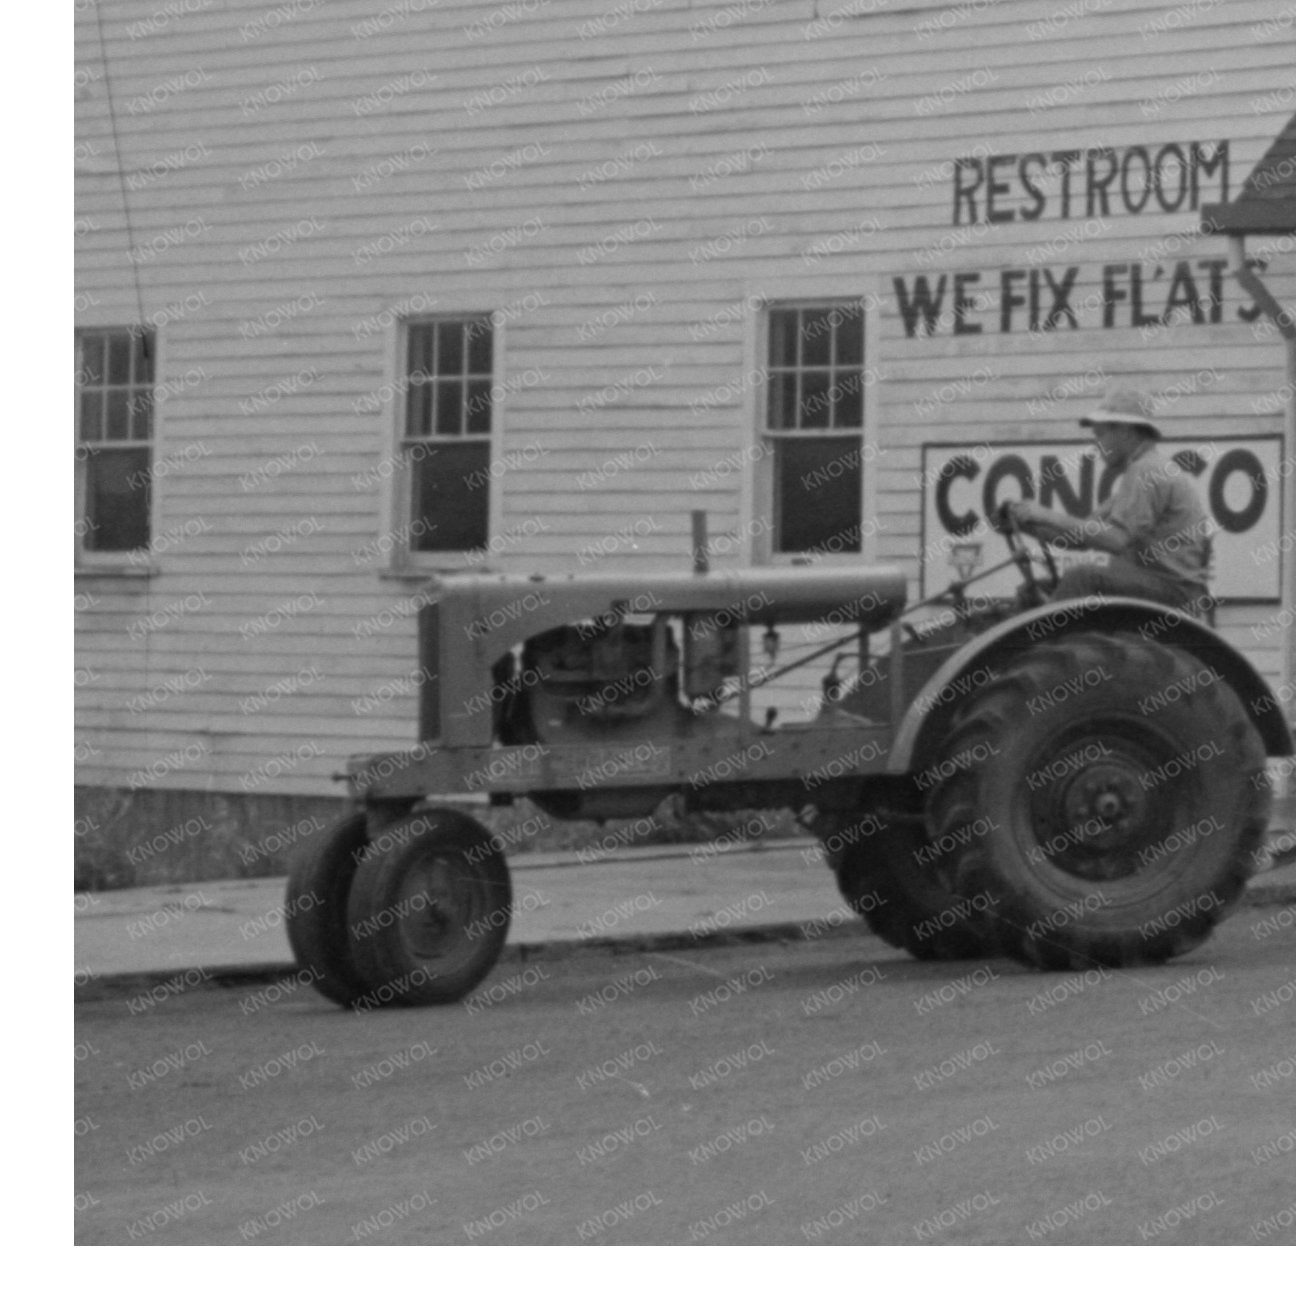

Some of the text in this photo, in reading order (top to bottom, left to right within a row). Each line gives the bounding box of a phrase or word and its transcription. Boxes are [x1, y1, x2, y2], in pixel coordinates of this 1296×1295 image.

[953, 139, 1231, 226] RESTROOM
[893, 272, 983, 338] WE
[1001, 266, 1080, 333] FIX
[936, 448, 1268, 537] CONO
